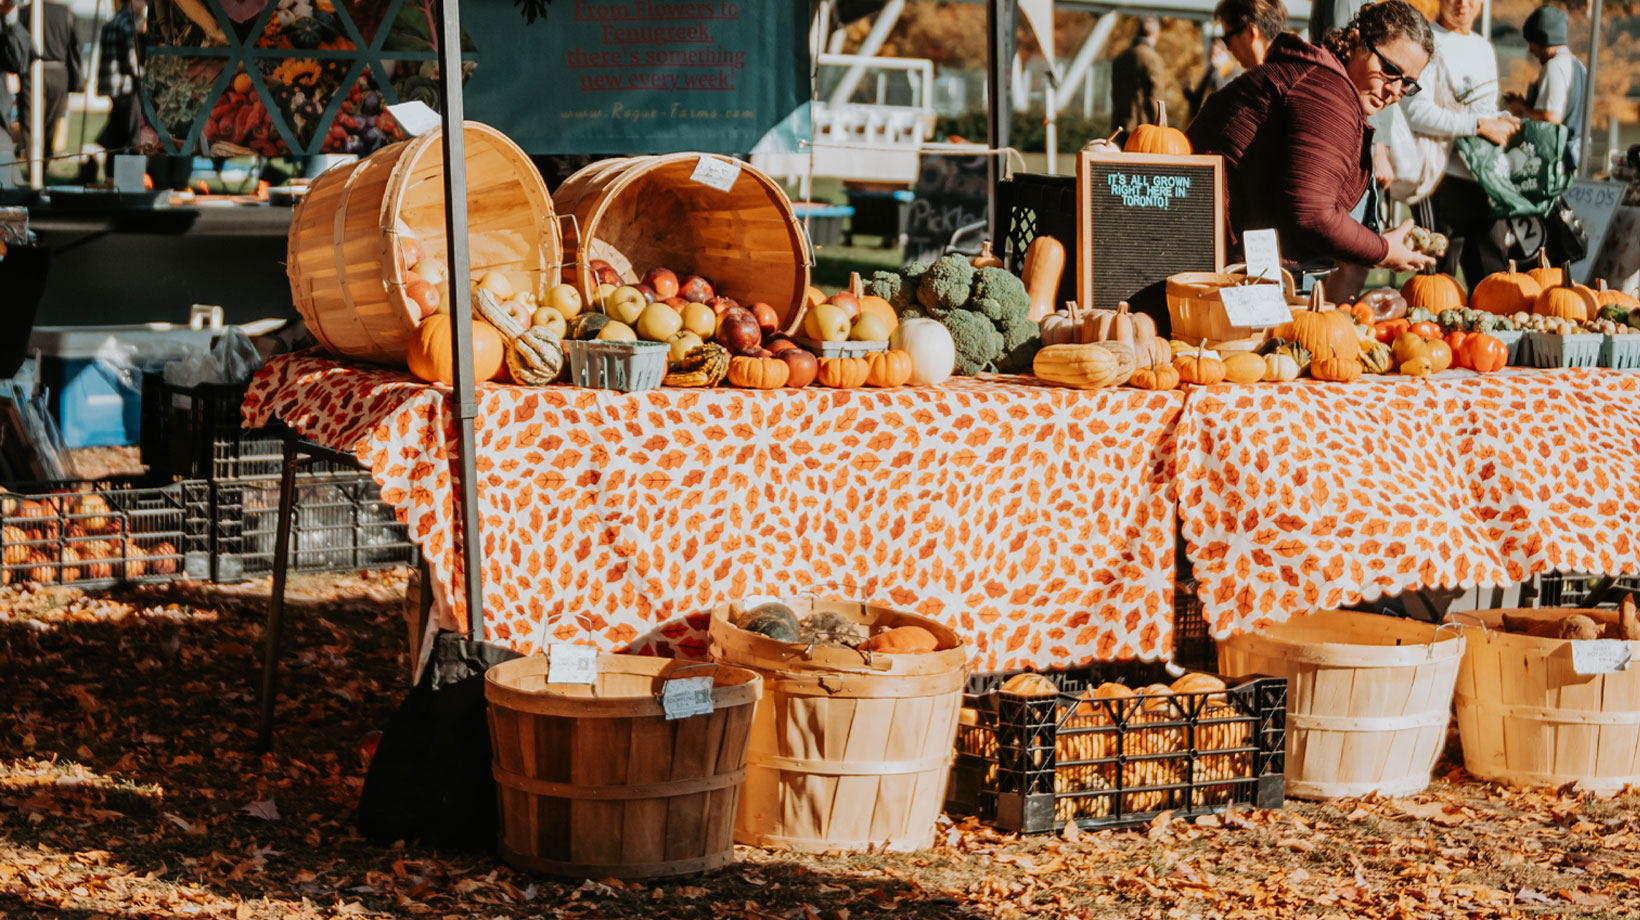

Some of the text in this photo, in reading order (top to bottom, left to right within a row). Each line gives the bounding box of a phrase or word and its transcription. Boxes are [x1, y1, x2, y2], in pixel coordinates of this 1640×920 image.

[575, 0, 740, 20] From Flowers to
[602, 22, 715, 45] Fenugreek,
[567, 46, 746, 70] there's something
[579, 69, 736, 93] new every week!
[1107, 171, 1191, 188] IT'S ALL GROWN
[1110, 184, 1187, 198] RIGHT HERE IN
[1121, 194, 1169, 211] TORONTO!
